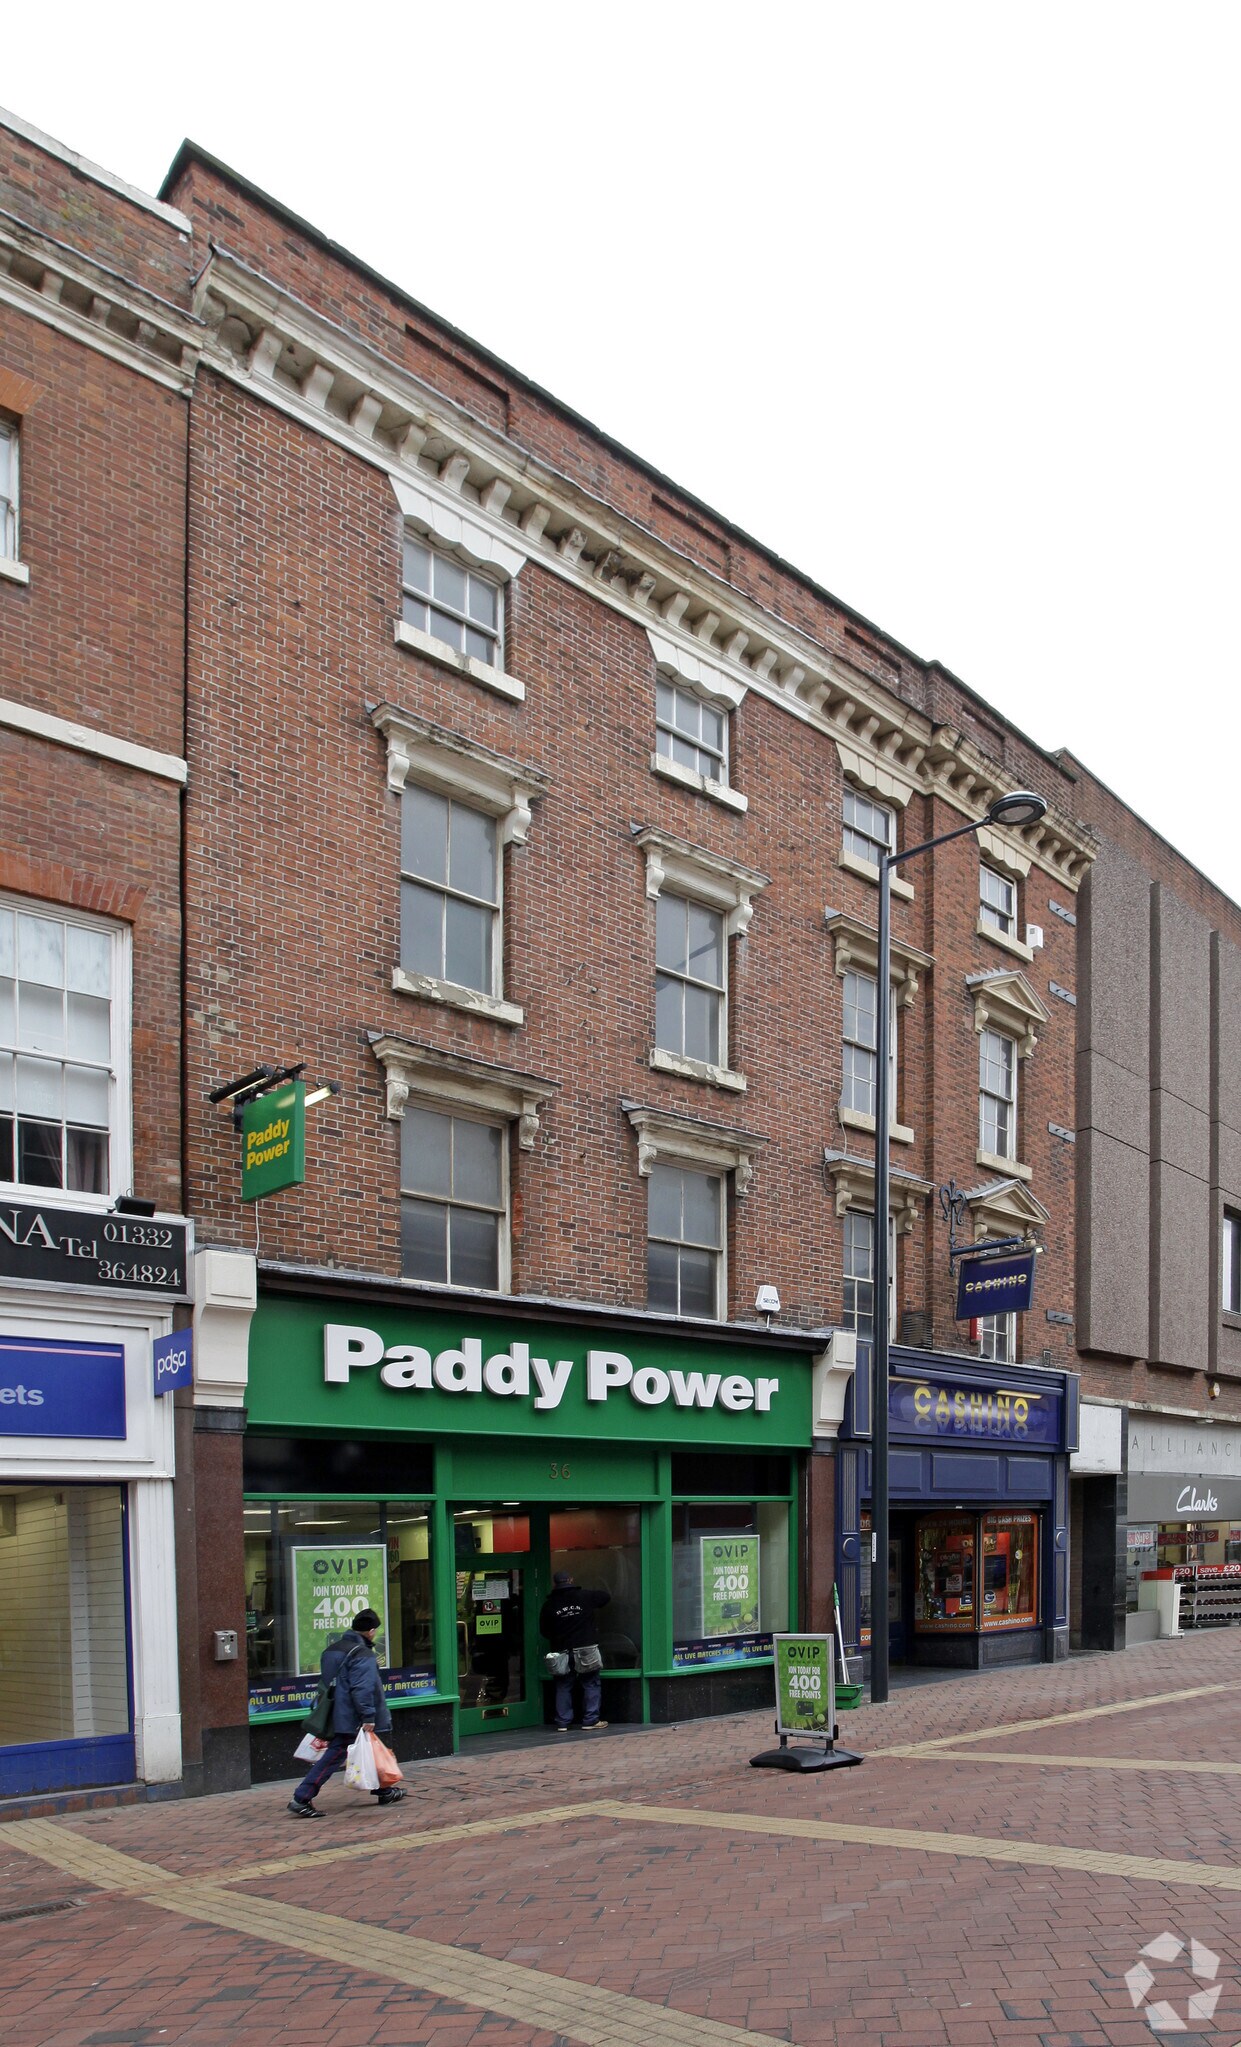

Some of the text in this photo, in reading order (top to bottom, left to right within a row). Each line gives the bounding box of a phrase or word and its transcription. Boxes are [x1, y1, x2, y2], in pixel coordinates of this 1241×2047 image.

[247, 1119, 290, 1150] Paddy
[246, 1140, 290, 1170] Power
[60, 1223, 173, 1259] Tel 01332
[98, 1260, 181, 1287] 364824
[965, 1274, 1027, 1292] CASHINO
[157, 1348, 187, 1381] pdsa
[324, 1323, 779, 1411] Paddy Power
[914, 1387, 1028, 1423] CASHINO
[1132, 1435, 1241, 1457] ALLIANC
[551, 1462, 571, 1479] 36
[1176, 1485, 1218, 1512] Clarks
[998, 1515, 1013, 1523] CASH
[1013, 1515, 1032, 1523] PRIZES
[713, 1565, 749, 1575] JOIN TODAY FOR
[1223, 1564, 1241, 1572] £20
[313, 1584, 369, 1597] JOIN TODAY FOR
[713, 1574, 749, 1591] 400
[713, 1590, 749, 1601] FREE POINTS
[313, 1596, 370, 1617] 400
[314, 1618, 335, 1630] FREE
[984, 1616, 1033, 1628] www.cashino.com
[674, 1653, 683, 1661] ALL
[685, 1651, 696, 1660] LIVE
[697, 1649, 721, 1659] MATCHES
[743, 1646, 751, 1654] ALL
[797, 1666, 811, 1675] TODAY
[812, 1666, 821, 1675] FOR
[394, 1680, 429, 1691] MATCHES
[789, 1675, 821, 1691] 400
[250, 1696, 264, 1705] ALL
[267, 1694, 285, 1704] LIVE
[789, 1690, 821, 1699] FREE POINTS
